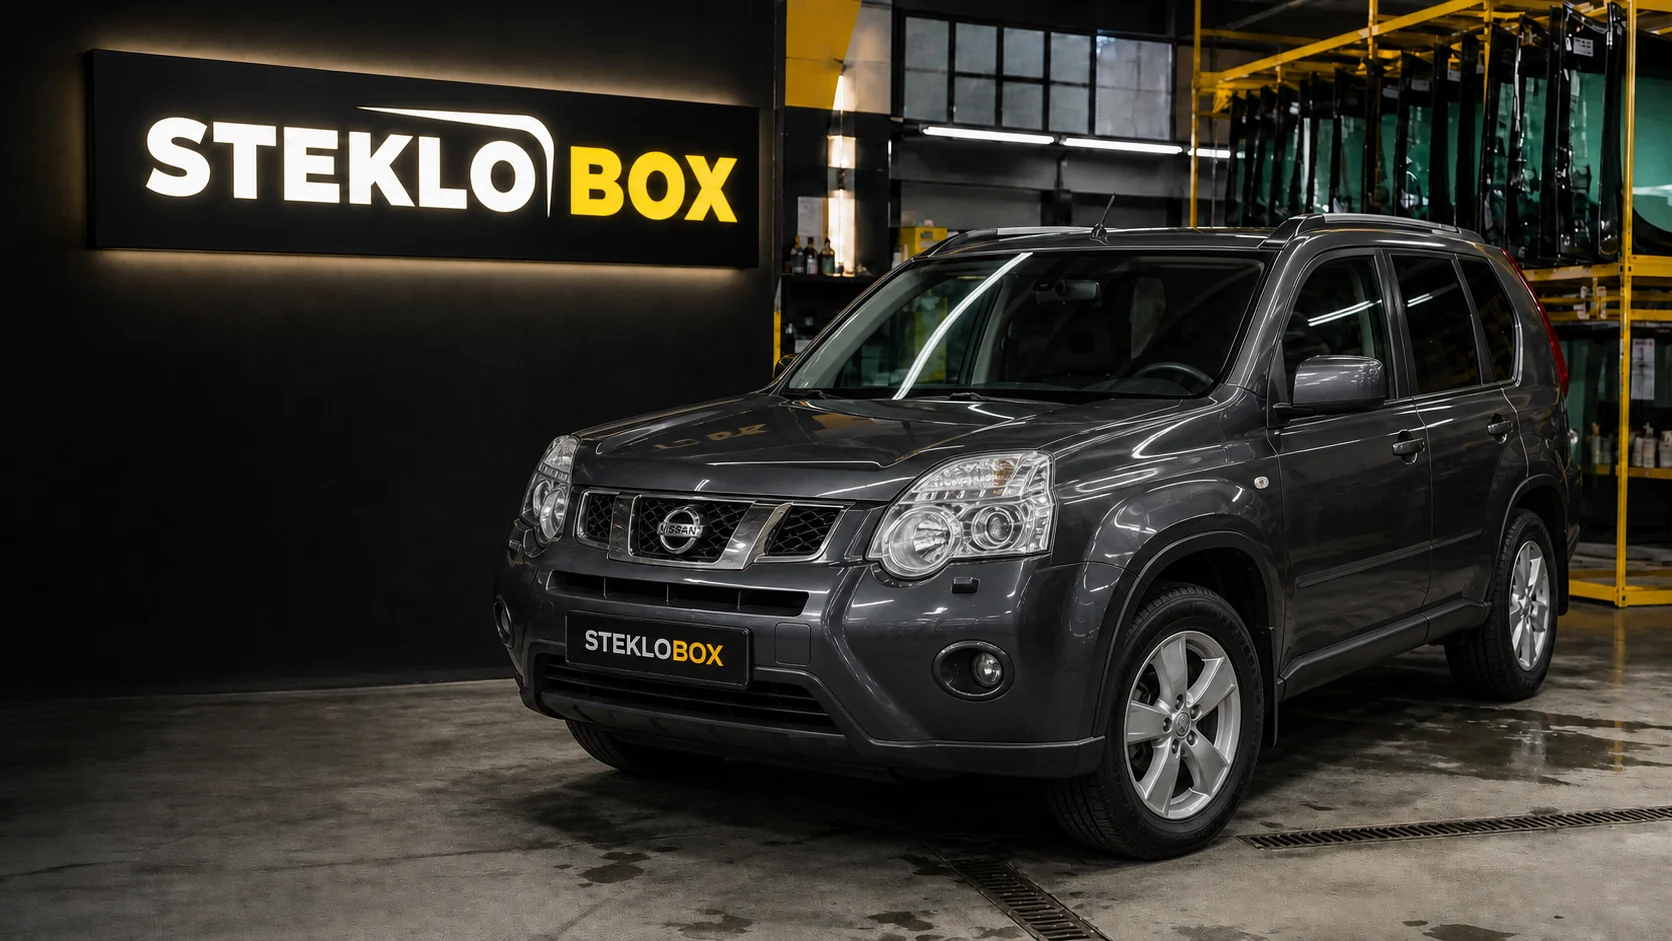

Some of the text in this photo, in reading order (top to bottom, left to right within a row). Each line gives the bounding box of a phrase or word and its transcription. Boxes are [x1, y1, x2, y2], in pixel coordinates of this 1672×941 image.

[145, 116, 738, 223] STEKLO BOX
[585, 629, 724, 667] STEKLOBOX
